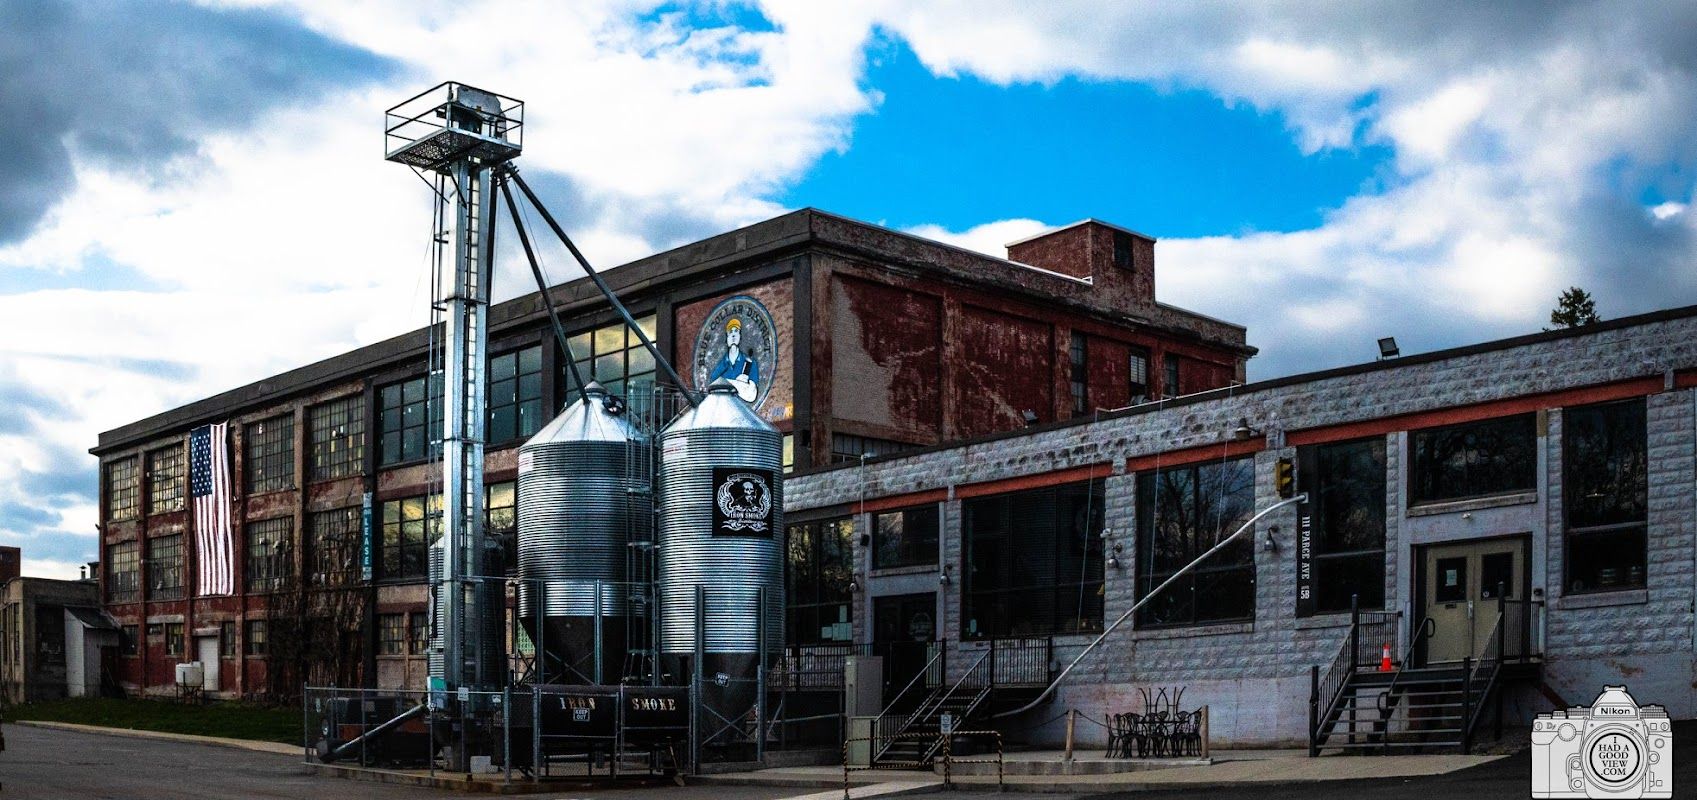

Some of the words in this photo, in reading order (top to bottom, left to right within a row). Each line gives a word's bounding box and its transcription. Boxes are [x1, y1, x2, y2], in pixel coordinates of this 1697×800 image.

[710, 304, 744, 331] COLLAR
[747, 307, 772, 354] DISTRICT
[1302, 530, 1311, 559] PARCE
[1301, 562, 1310, 579] AVE
[559, 697, 596, 710] IRON
[632, 697, 676, 711] SMOKE
